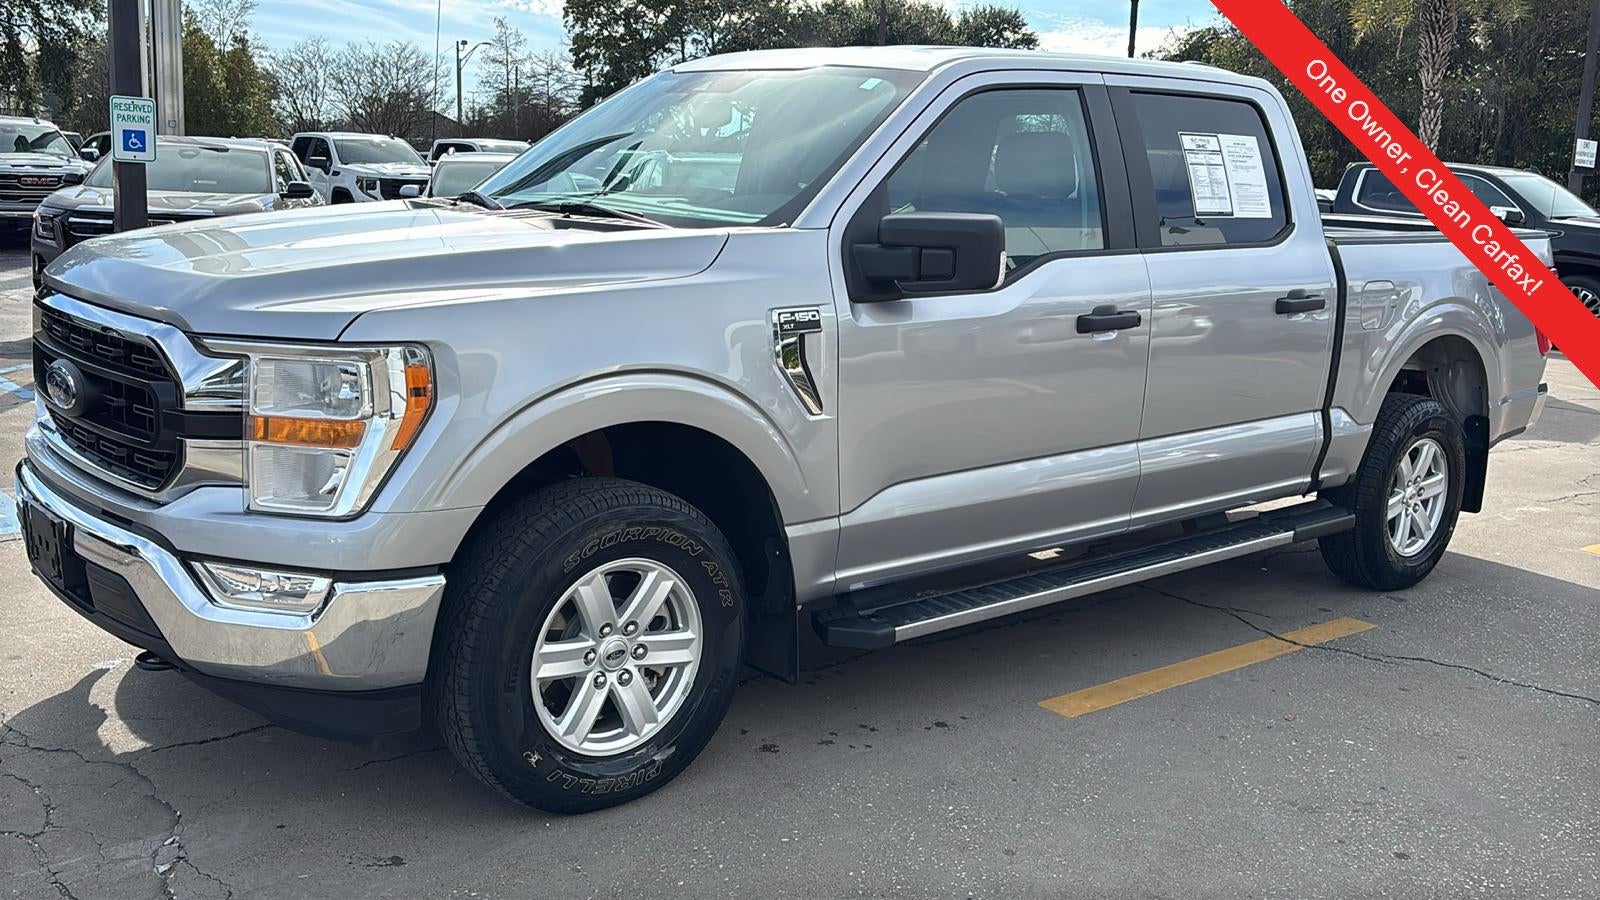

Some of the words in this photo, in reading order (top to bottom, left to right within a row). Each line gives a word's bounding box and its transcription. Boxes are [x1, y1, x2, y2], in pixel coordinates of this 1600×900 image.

[113, 102, 153, 113] RESERVED
[116, 114, 151, 124] PARKING
[20, 177, 59, 185] GMC
[780, 311, 819, 323] F-150
[563, 527, 703, 573] SCORPION
[701, 560, 734, 608] ATR
[546, 760, 663, 795] PIRELLI
